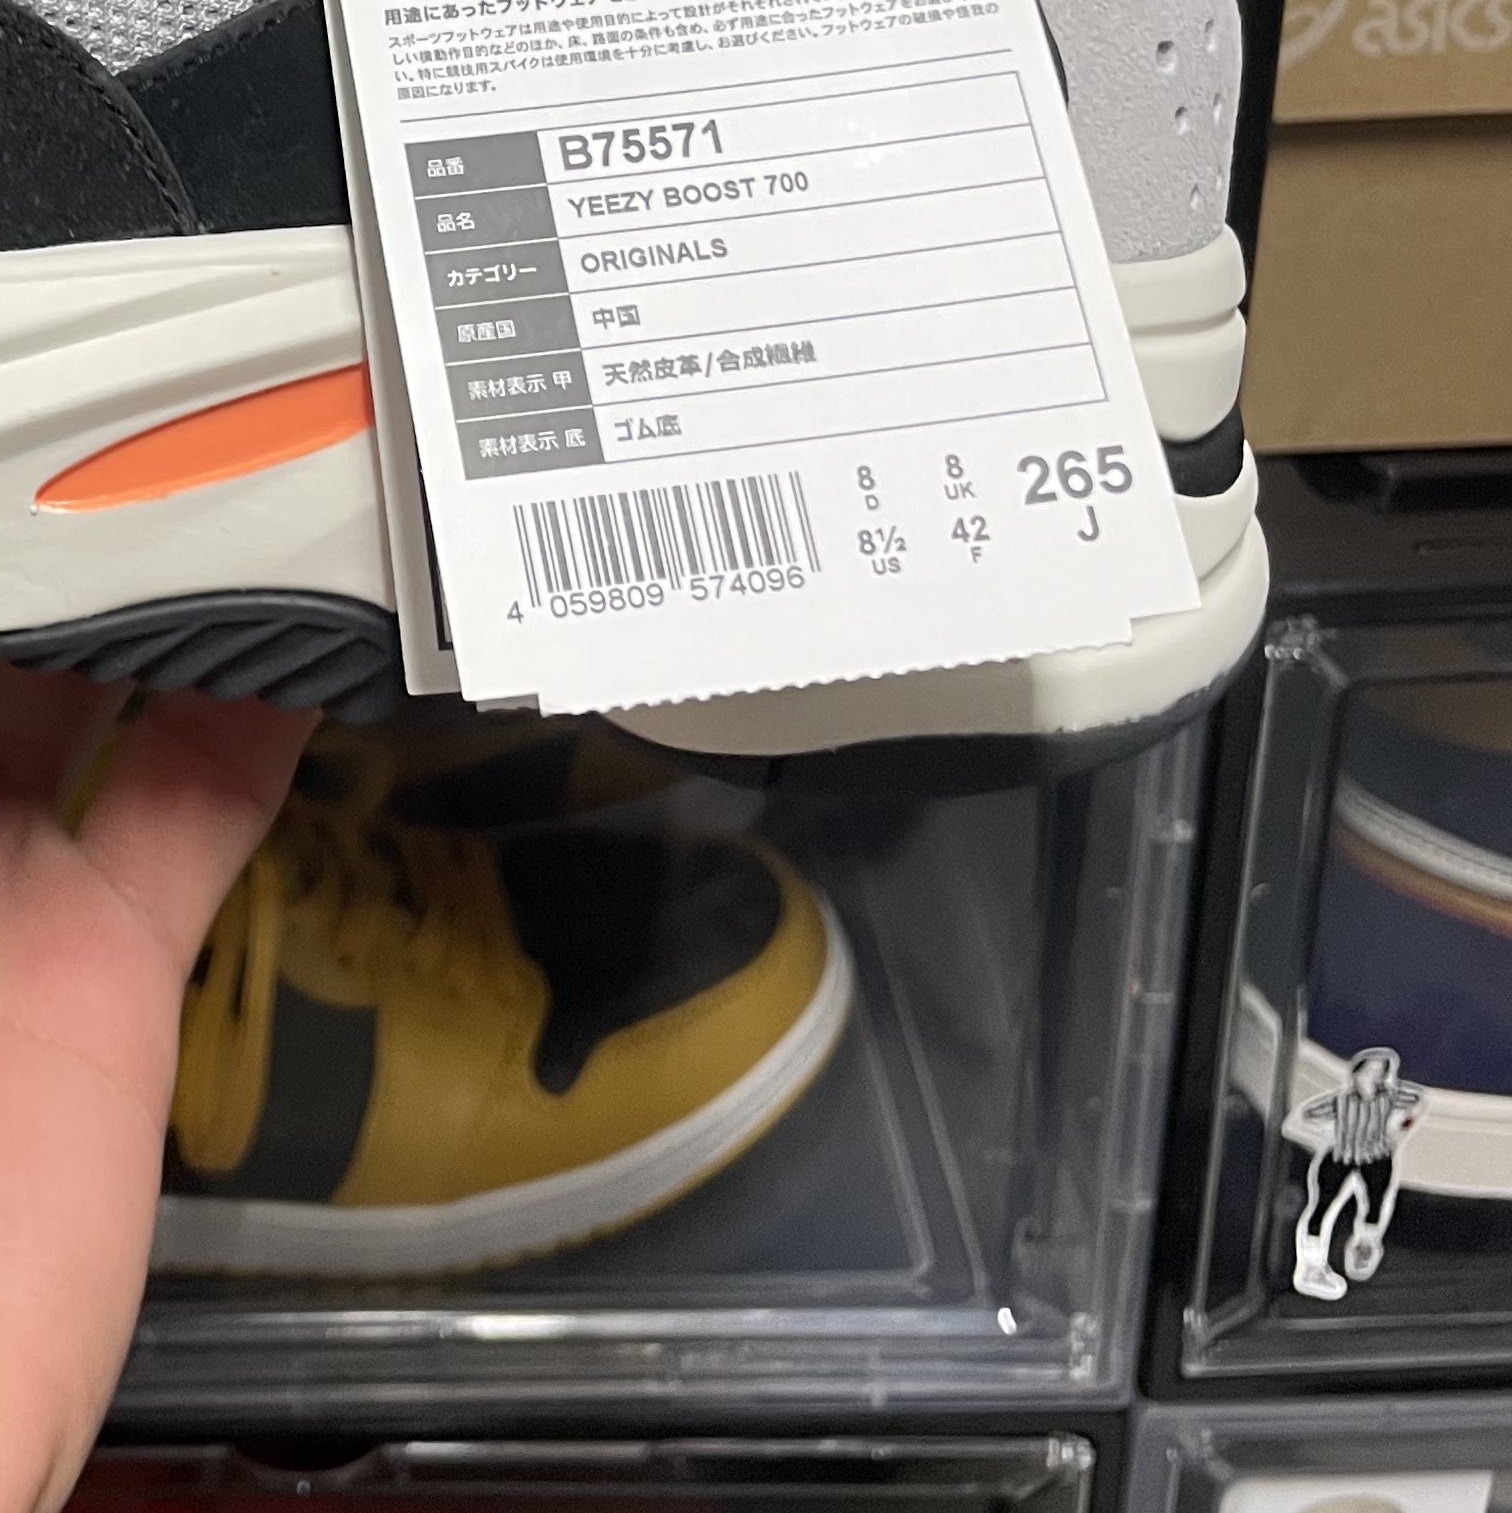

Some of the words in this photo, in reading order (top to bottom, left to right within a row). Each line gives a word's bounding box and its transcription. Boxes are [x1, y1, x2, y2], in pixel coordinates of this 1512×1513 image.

[397, 78, 497, 100] 原因になります。
[558, 118, 724, 172] B75571
[426, 156, 465, 178] 品番
[568, 190, 656, 218] YEEZY
[664, 177, 756, 208] BOOST
[763, 171, 809, 196] 700
[436, 211, 476, 234] 品名
[580, 237, 729, 274] ORIGINALS
[447, 263, 538, 288] カテゴリー
[592, 303, 642, 330] 中国
[456, 319, 517, 344] 原産国
[467, 373, 547, 401] 素材表示
[552, 369, 572, 391] 甲
[613, 413, 683, 443] ゴム底
[478, 431, 559, 459] 素材表示
[564, 427, 586, 448] 底
[856, 464, 876, 491] 8
[944, 453, 964, 480] 8
[1016, 444, 1133, 506] 265
[864, 494, 880, 511] D
[943, 481, 977, 500] UK
[951, 514, 991, 543] 42
[1076, 504, 1100, 543] J
[871, 556, 902, 576] US
[970, 546, 983, 564] F
[506, 600, 525, 625] 4
[550, 582, 666, 619] 059809
[690, 565, 806, 602] 574096
